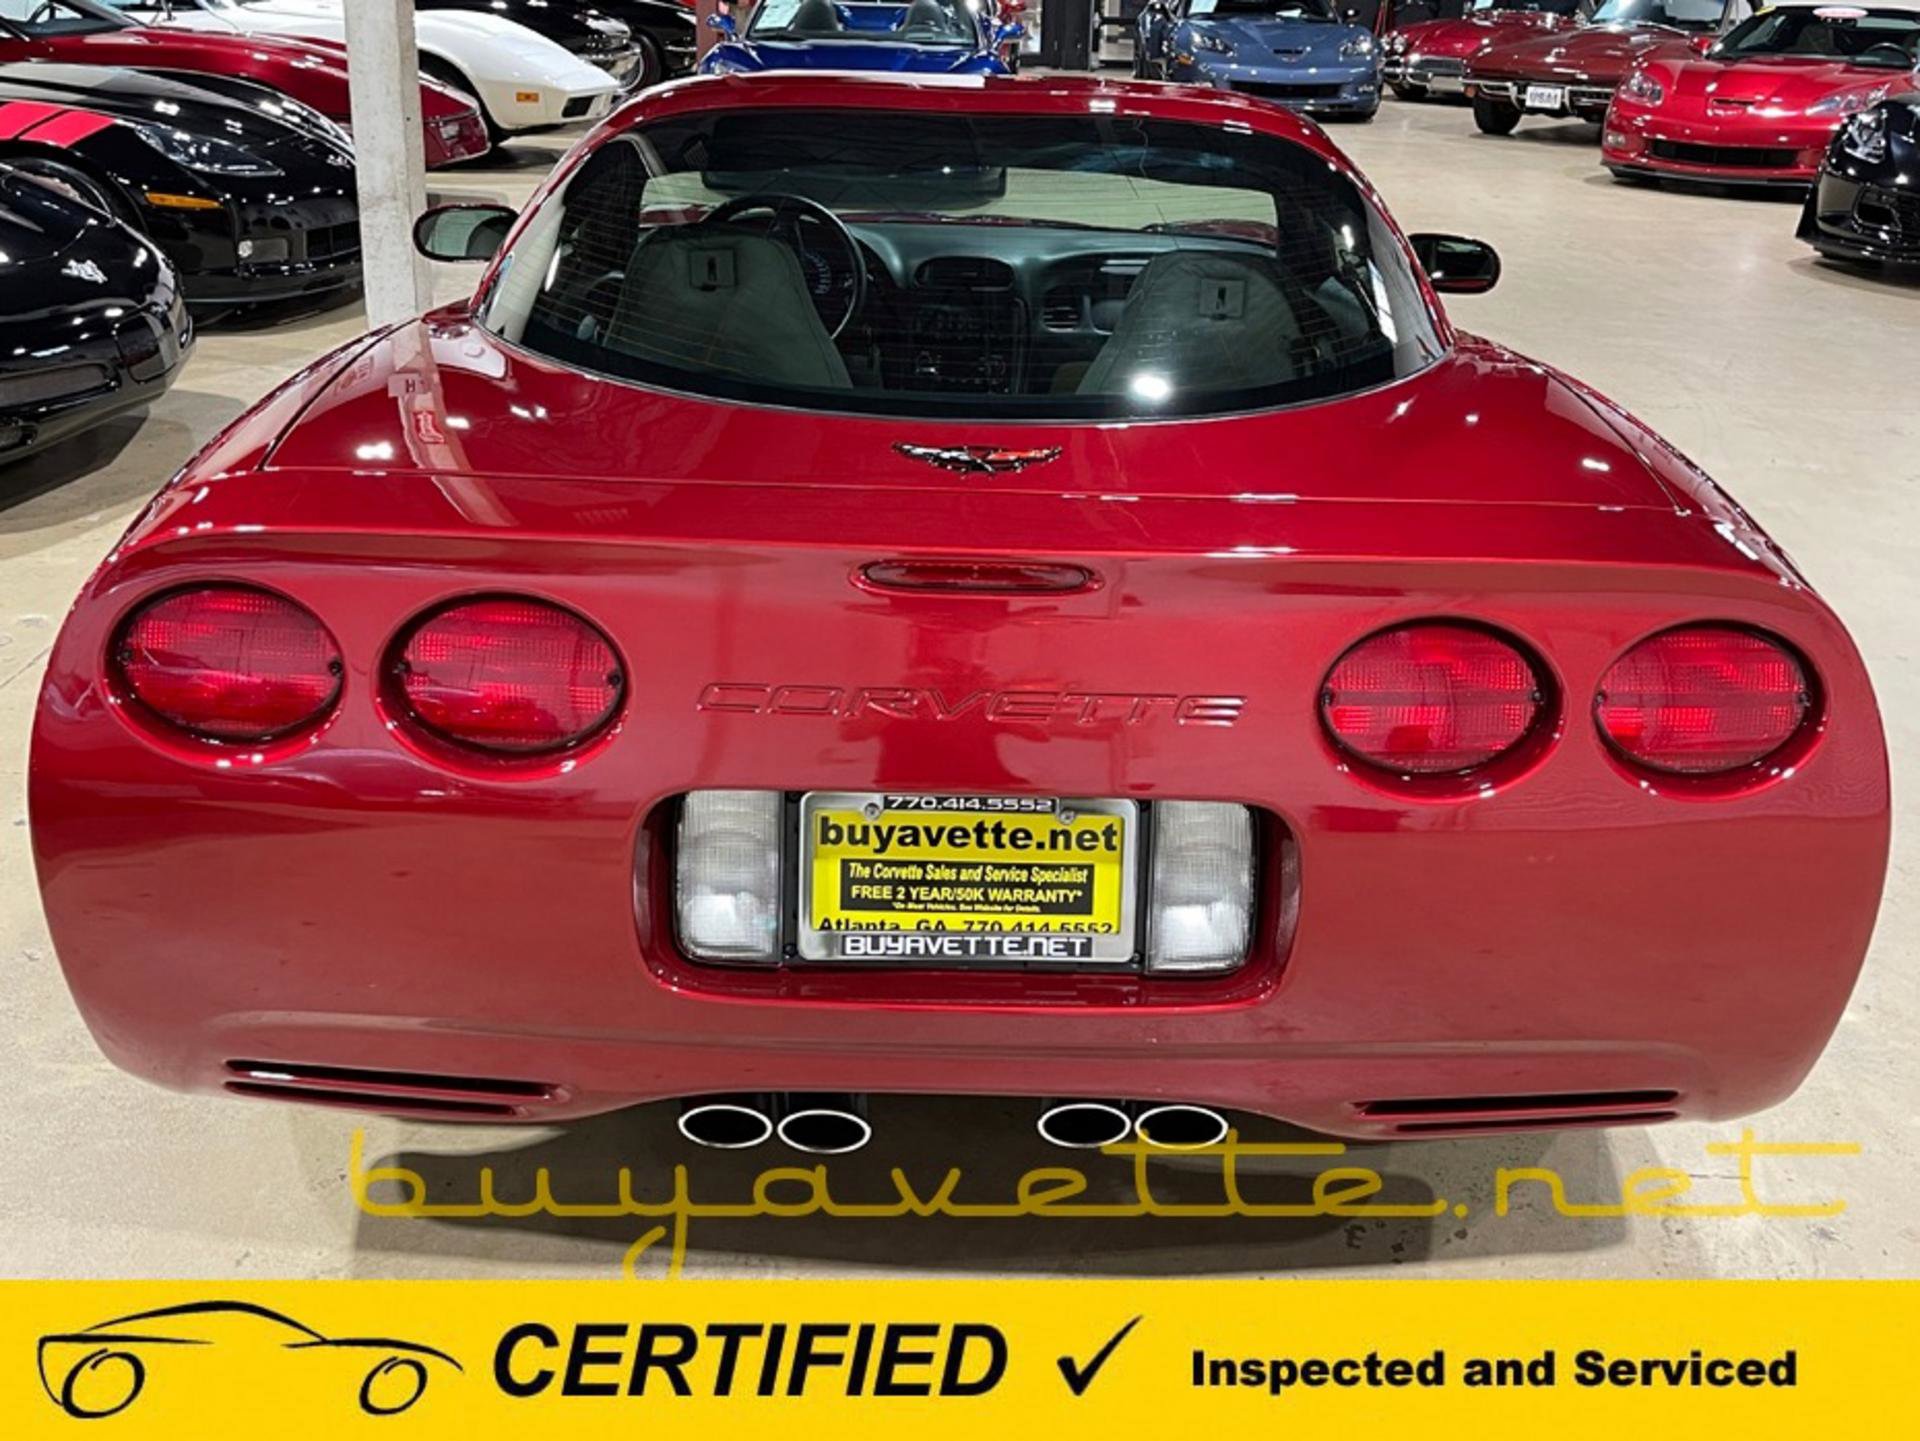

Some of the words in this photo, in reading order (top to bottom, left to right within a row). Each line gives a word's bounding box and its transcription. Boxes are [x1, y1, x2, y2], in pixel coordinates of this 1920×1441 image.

[698, 682, 1247, 727] CORVETTE
[886, 795, 1053, 812] 770.414.5552
[819, 815, 1119, 855] buyavette.net
[849, 862, 872, 879] The
[873, 863, 924, 880] Corvette
[925, 864, 957, 881] Sales
[959, 866, 984, 881] and
[984, 865, 1029, 883] Service
[1030, 866, 1089, 886] Specialist
[851, 885, 894, 900] FREE
[896, 885, 906, 900] 2
[909, 886, 985, 902] YEAR/50K
[844, 935, 1088, 957] BUYAVETTE.NET
